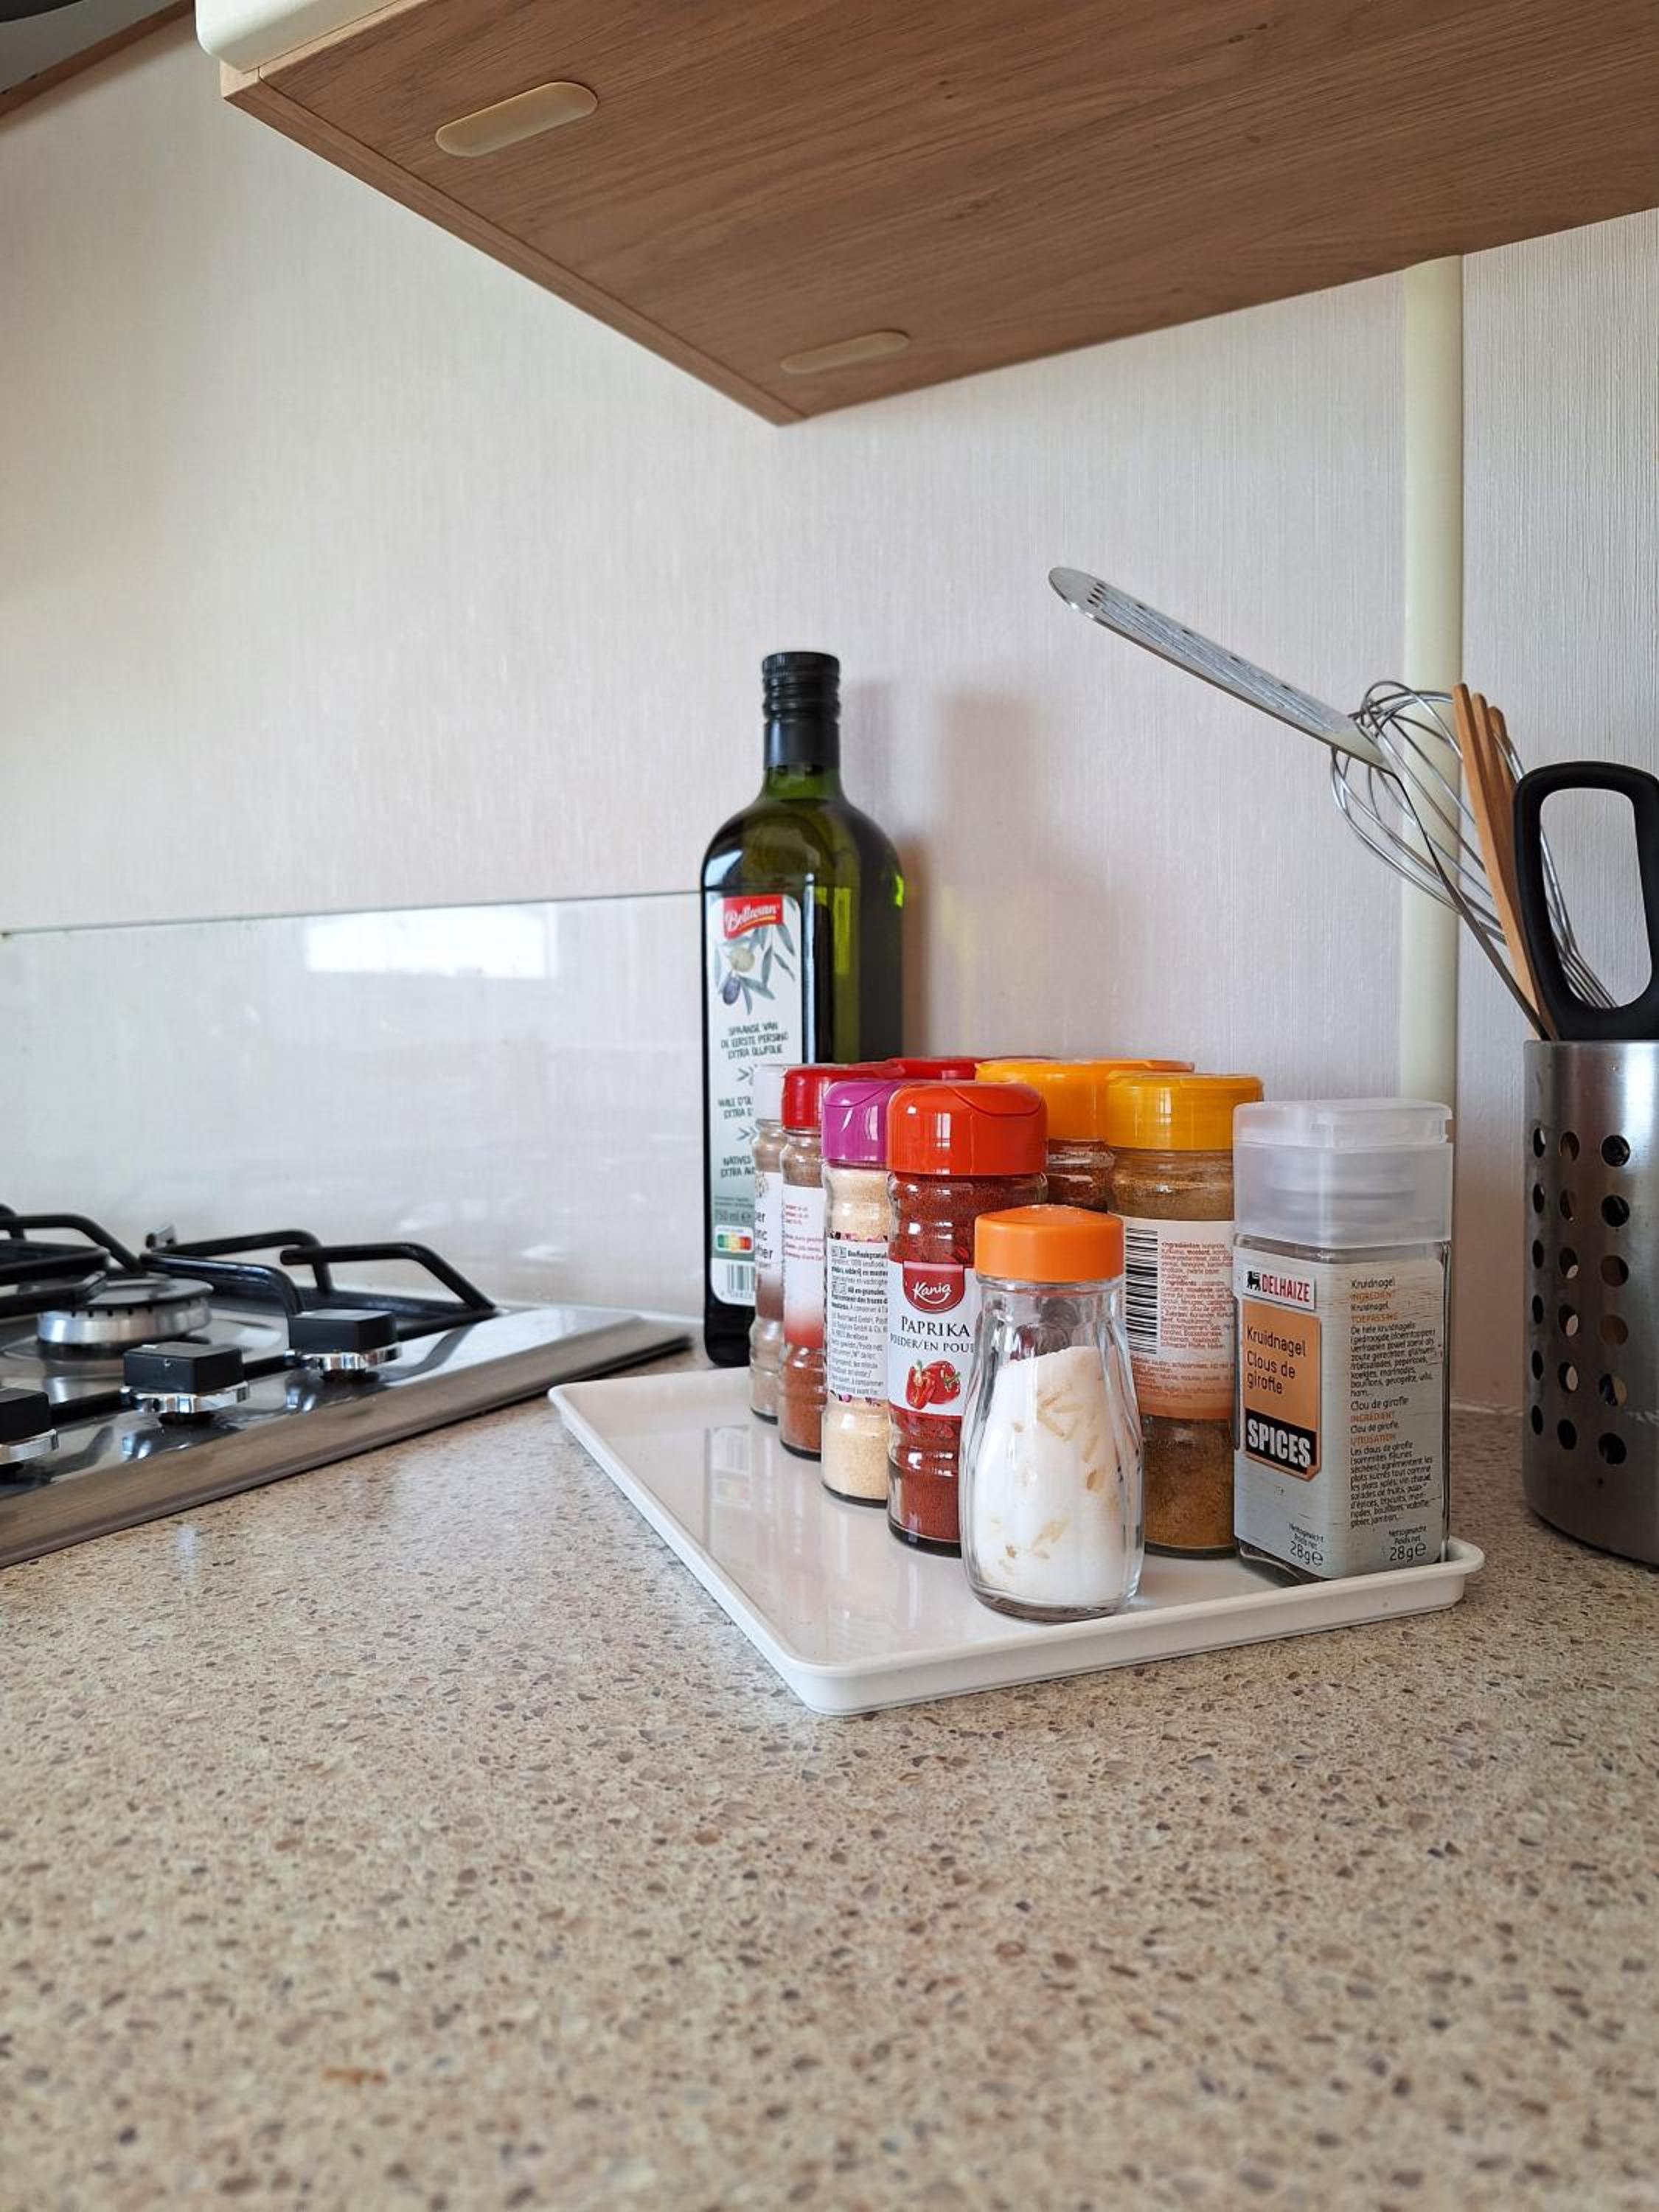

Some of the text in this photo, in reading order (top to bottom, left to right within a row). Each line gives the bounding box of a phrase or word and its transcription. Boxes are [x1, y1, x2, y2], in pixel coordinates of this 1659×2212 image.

[762, 1022, 779, 1031] VAN
[731, 1035, 756, 1047] EERSTE
[728, 1047, 750, 1060] EXTRA
[1262, 1273, 1310, 1303] DELHAIZE
[1351, 1277, 1396, 1290] Kruidnagel
[913, 1281, 952, 1302] Kania
[901, 1315, 970, 1338] PAPRIKA
[1351, 1326, 1360, 1335] De
[1247, 1325, 1306, 1357] Kruidnagel
[1247, 1350, 1278, 1374] Clous
[1281, 1361, 1295, 1380] de
[1247, 1371, 1283, 1395] girofle
[1351, 1396, 1409, 1411] Clou de girofle
[1351, 1424, 1366, 1434] Clou
[1368, 1423, 1377, 1432] de
[1248, 1418, 1312, 1468] SPICES
[1351, 1447, 1362, 1457] Les
